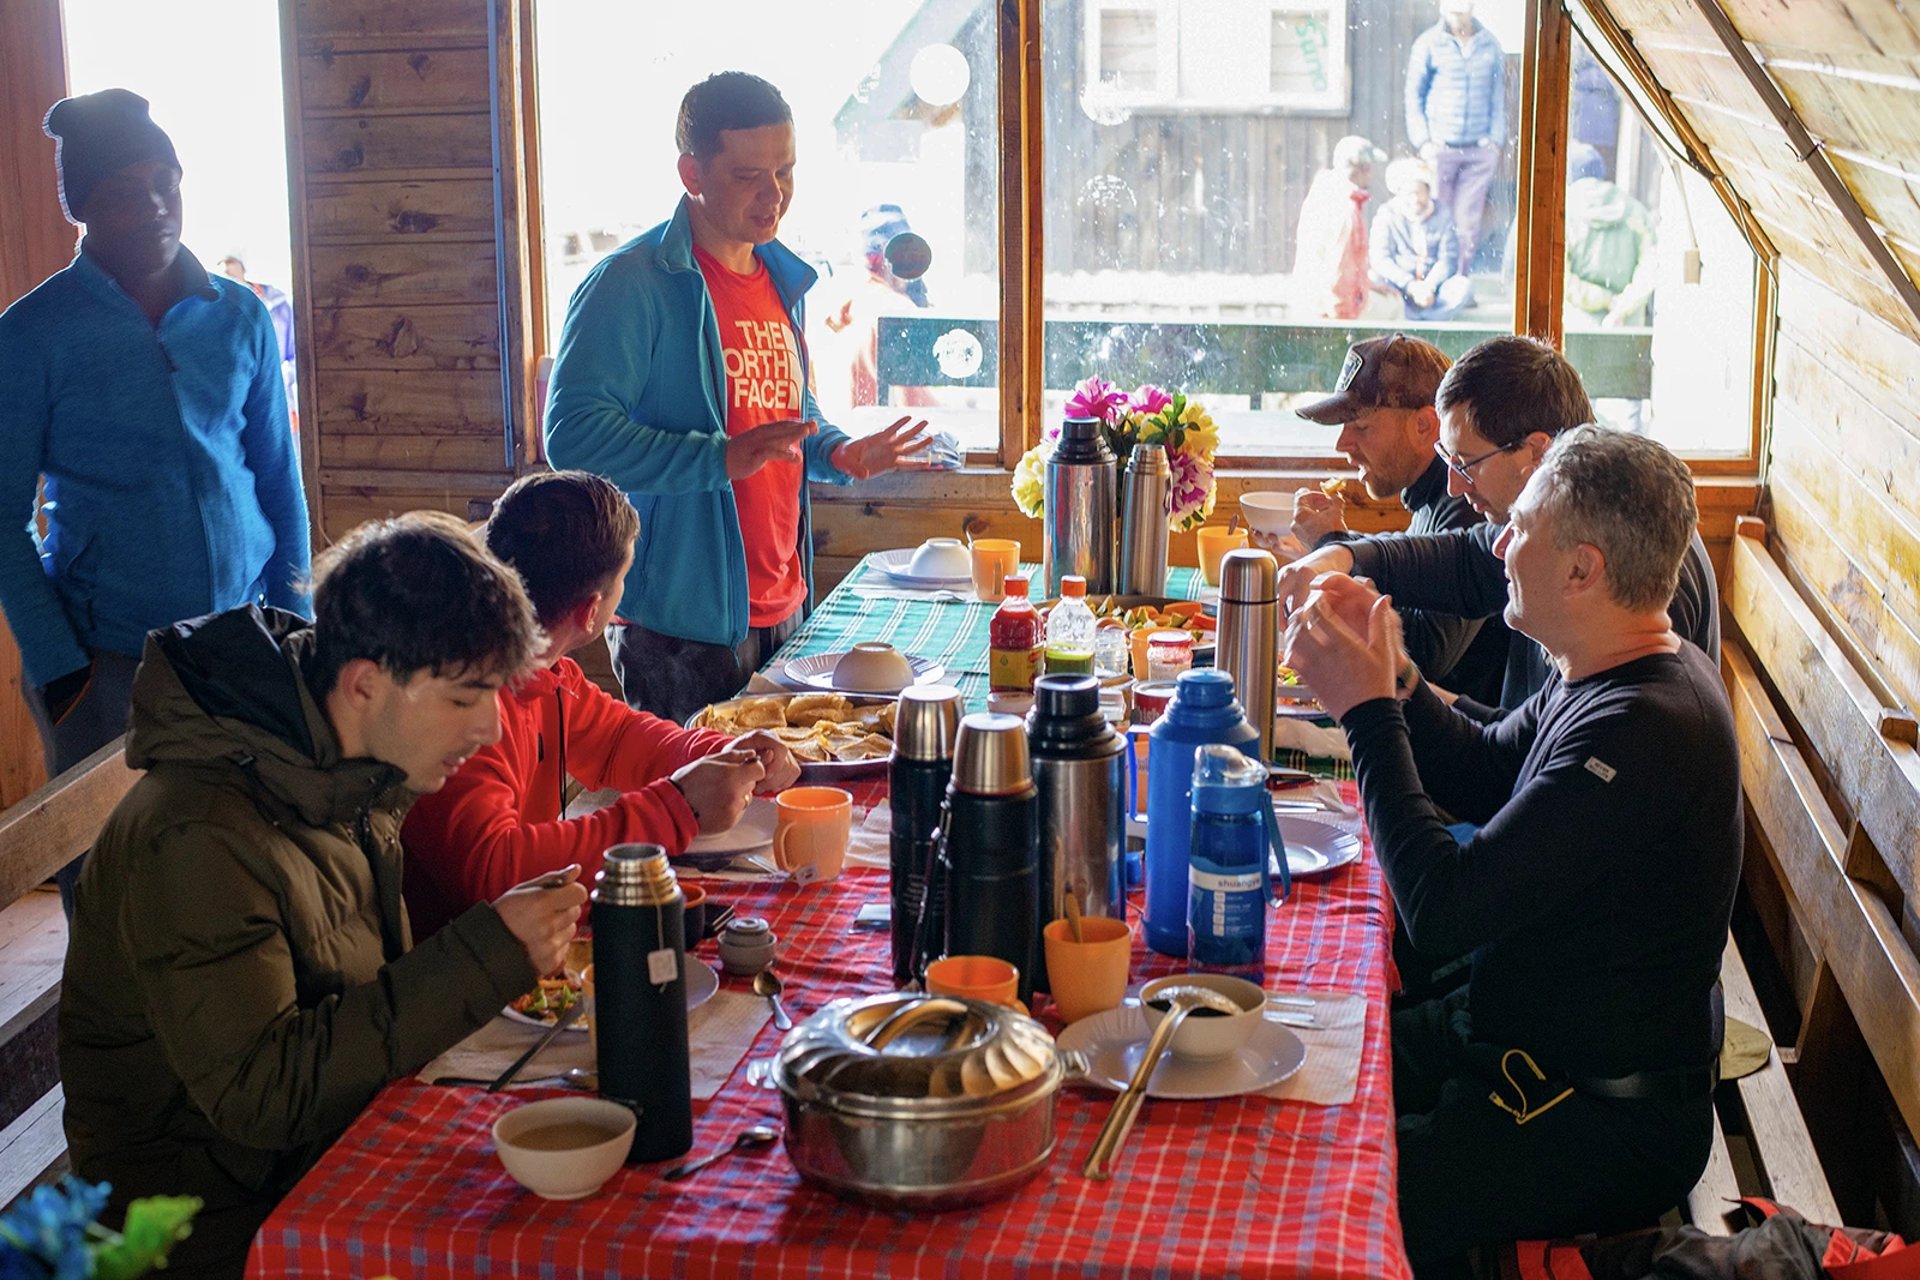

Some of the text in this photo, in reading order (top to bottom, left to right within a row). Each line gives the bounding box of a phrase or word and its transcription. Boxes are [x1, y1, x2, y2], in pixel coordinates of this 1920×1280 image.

[735, 320, 785, 350] THE
[724, 348, 788, 378] ORTH
[735, 379, 788, 409] FACE
